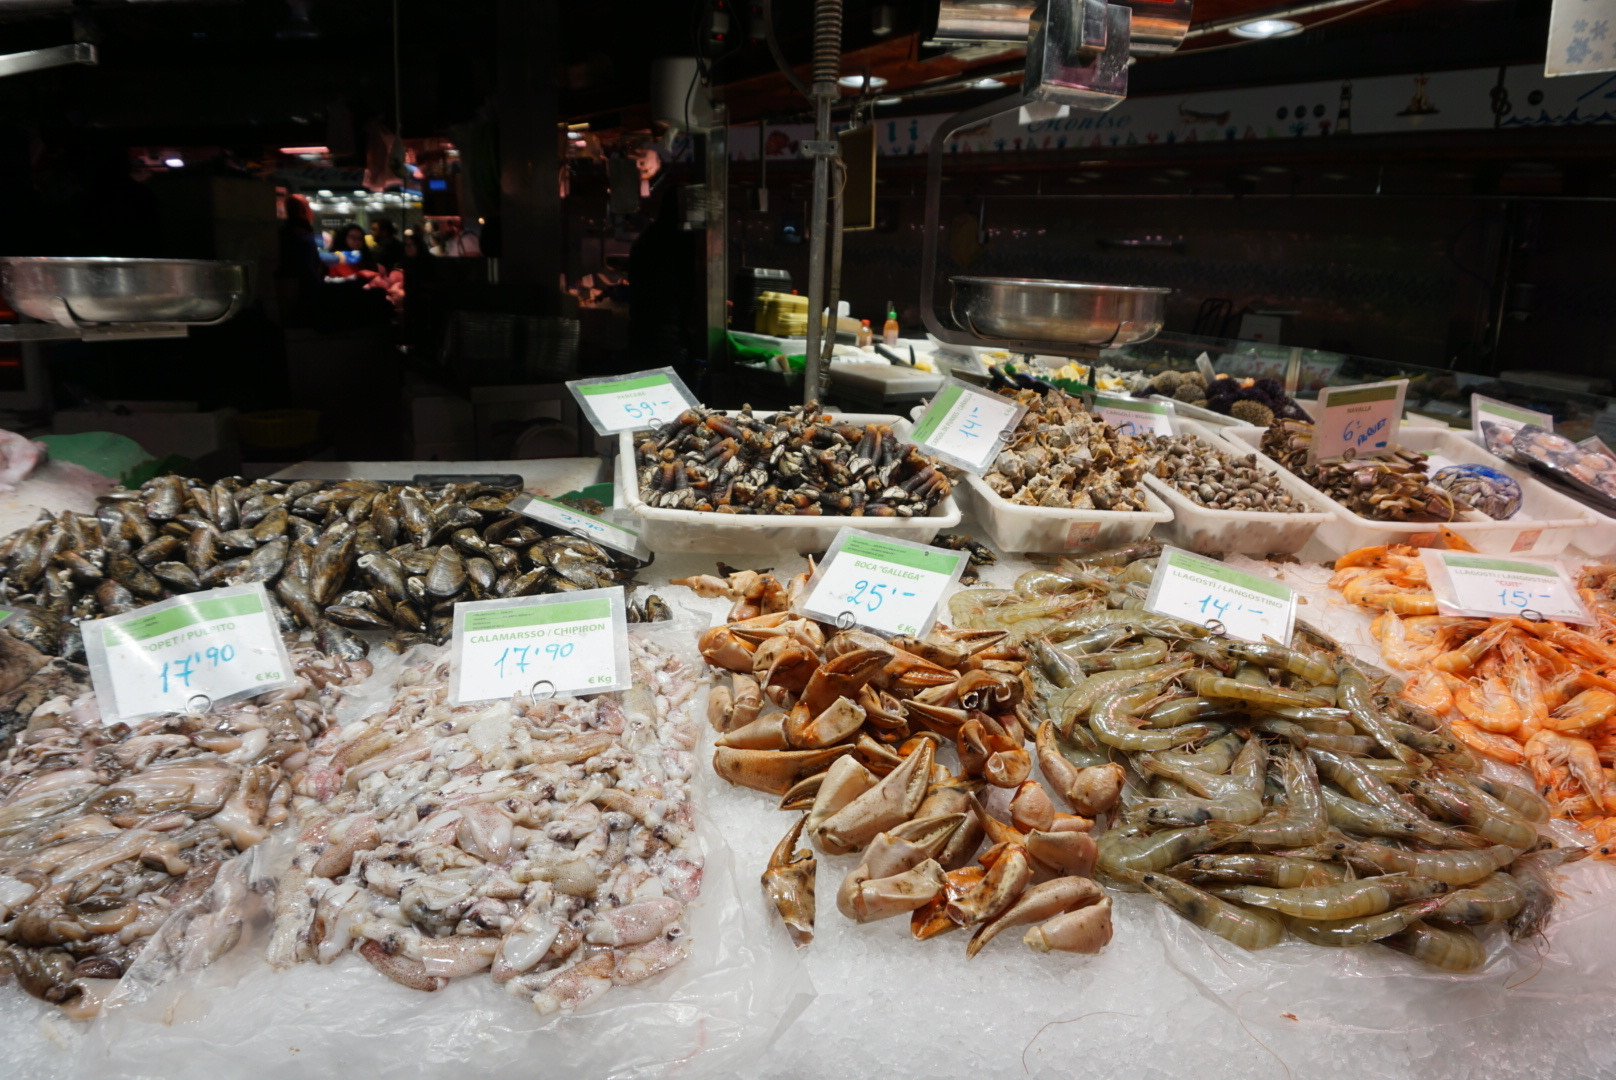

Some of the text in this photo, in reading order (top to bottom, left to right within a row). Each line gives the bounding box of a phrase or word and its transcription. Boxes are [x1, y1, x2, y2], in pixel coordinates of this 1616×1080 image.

[854, 560, 877, 572] BOCA
[1501, 573, 1558, 585] LANGOSTINO
[1222, 585, 1284, 609] LANGOSTINO
[470, 628, 545, 645] CALAMARSSO
[553, 623, 606, 637] CHIPIRON
[897, 623, 917, 634] € Kg
[494, 642, 575, 679] 17'90
[159, 644, 236, 693] 17'90
[255, 671, 281, 681] € Kg
[587, 675, 612, 685] € Kg
